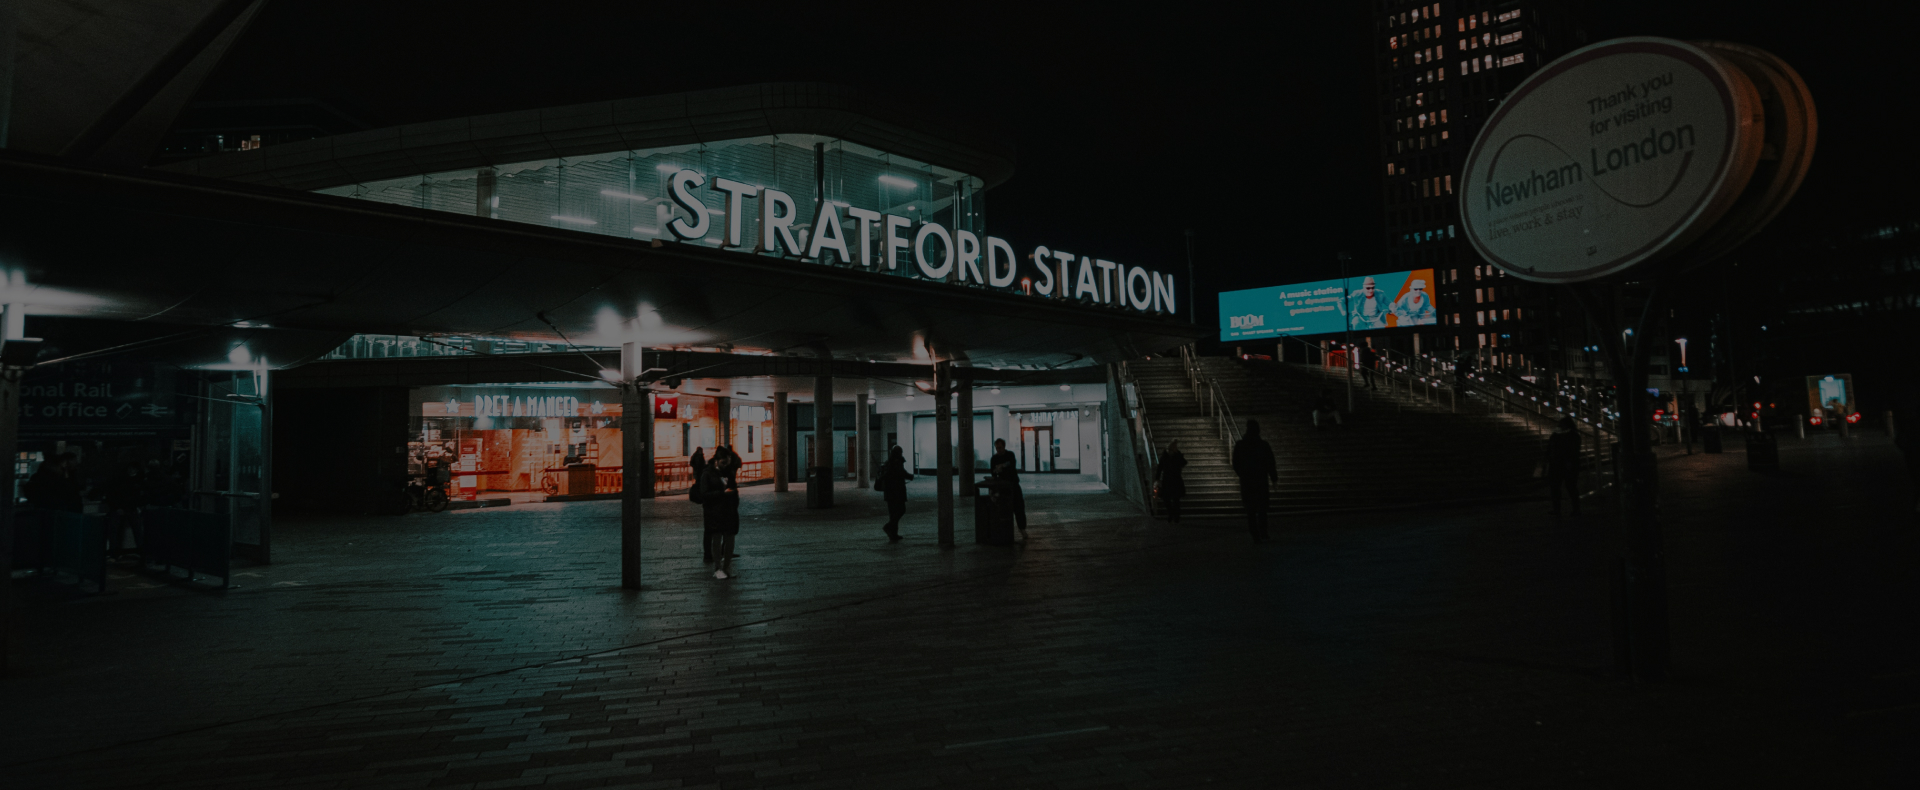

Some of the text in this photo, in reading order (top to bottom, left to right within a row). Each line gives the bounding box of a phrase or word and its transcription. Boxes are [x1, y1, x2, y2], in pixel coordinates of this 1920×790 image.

[1587, 72, 1673, 115] Thank you
[1590, 96, 1672, 136] for visiting
[1485, 124, 1695, 211] Newham London
[1513, 217, 1542, 232] work
[1544, 213, 1554, 226] &
[1557, 206, 1584, 222] stay
[667, 168, 1175, 315] STRATFORD STATION
[1279, 286, 1344, 300] A music station
[1230, 314, 1264, 328] BOOM
[73, 382, 113, 398] Rail
[41, 402, 108, 418] office
[474, 395, 580, 417] PRET A MANGER
